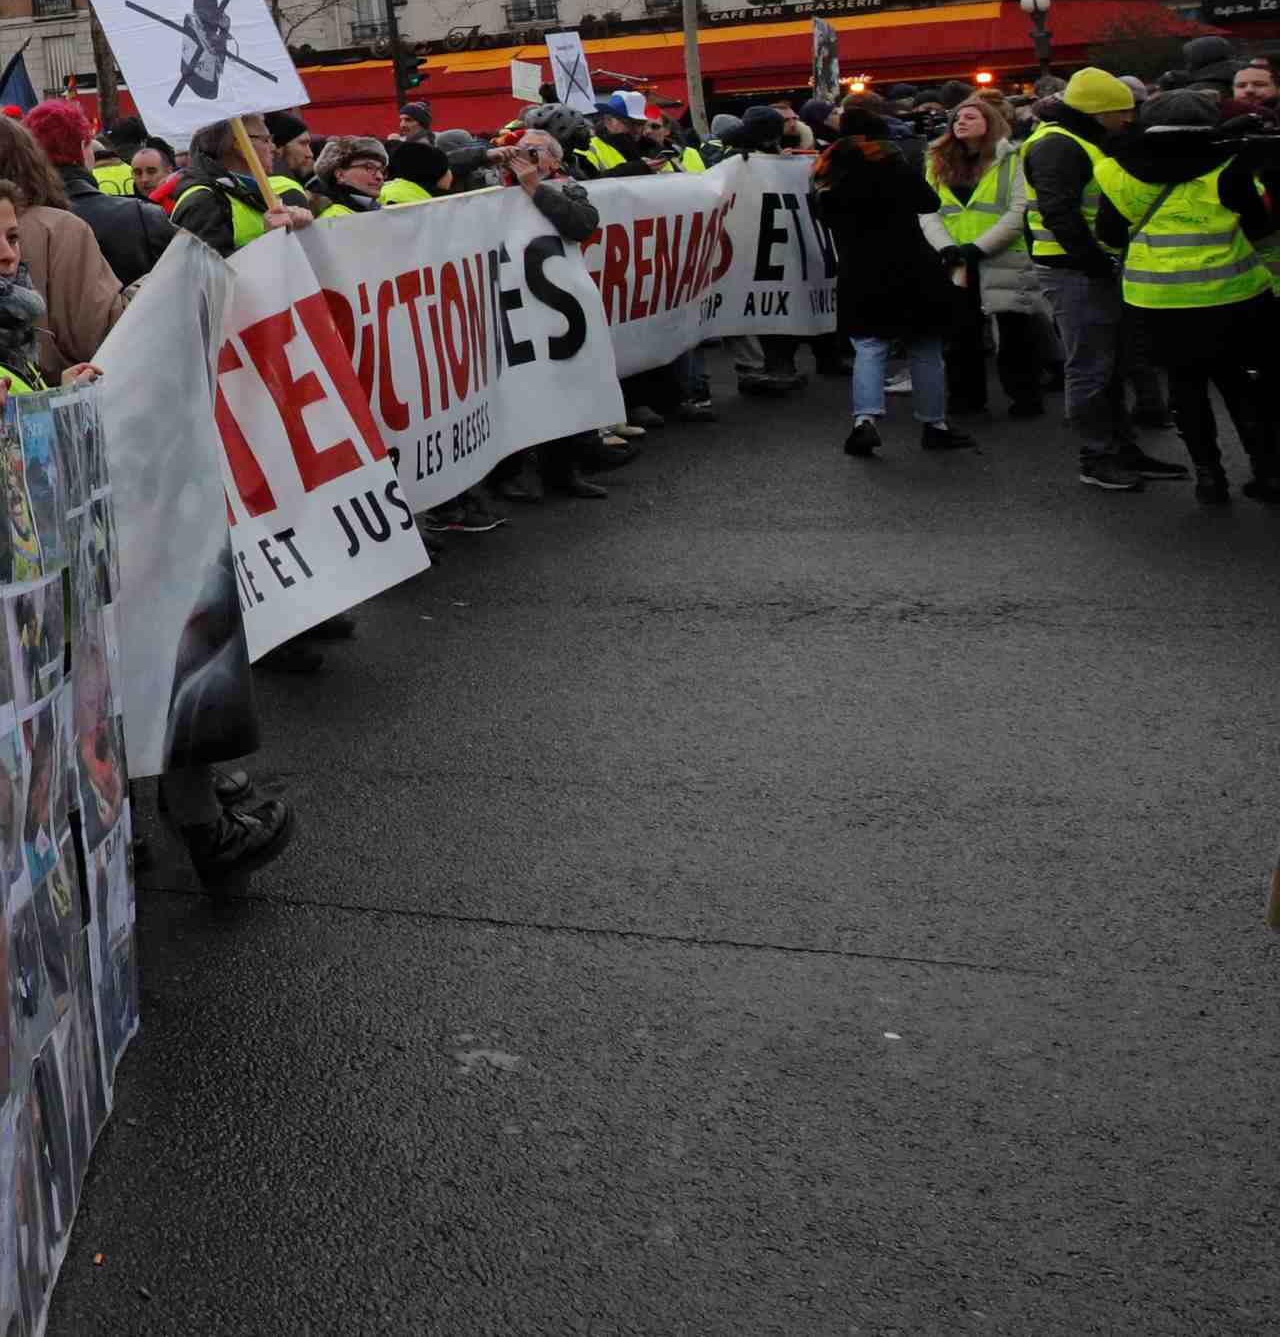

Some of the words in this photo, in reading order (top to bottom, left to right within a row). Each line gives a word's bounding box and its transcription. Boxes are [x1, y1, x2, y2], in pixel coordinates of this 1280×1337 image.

[752, 7, 782, 18] BAR
[743, 291, 789, 317] AUX
[416, 430, 443, 481] LES
[258, 528, 313, 588] ET
[332, 480, 414, 559] JUS
